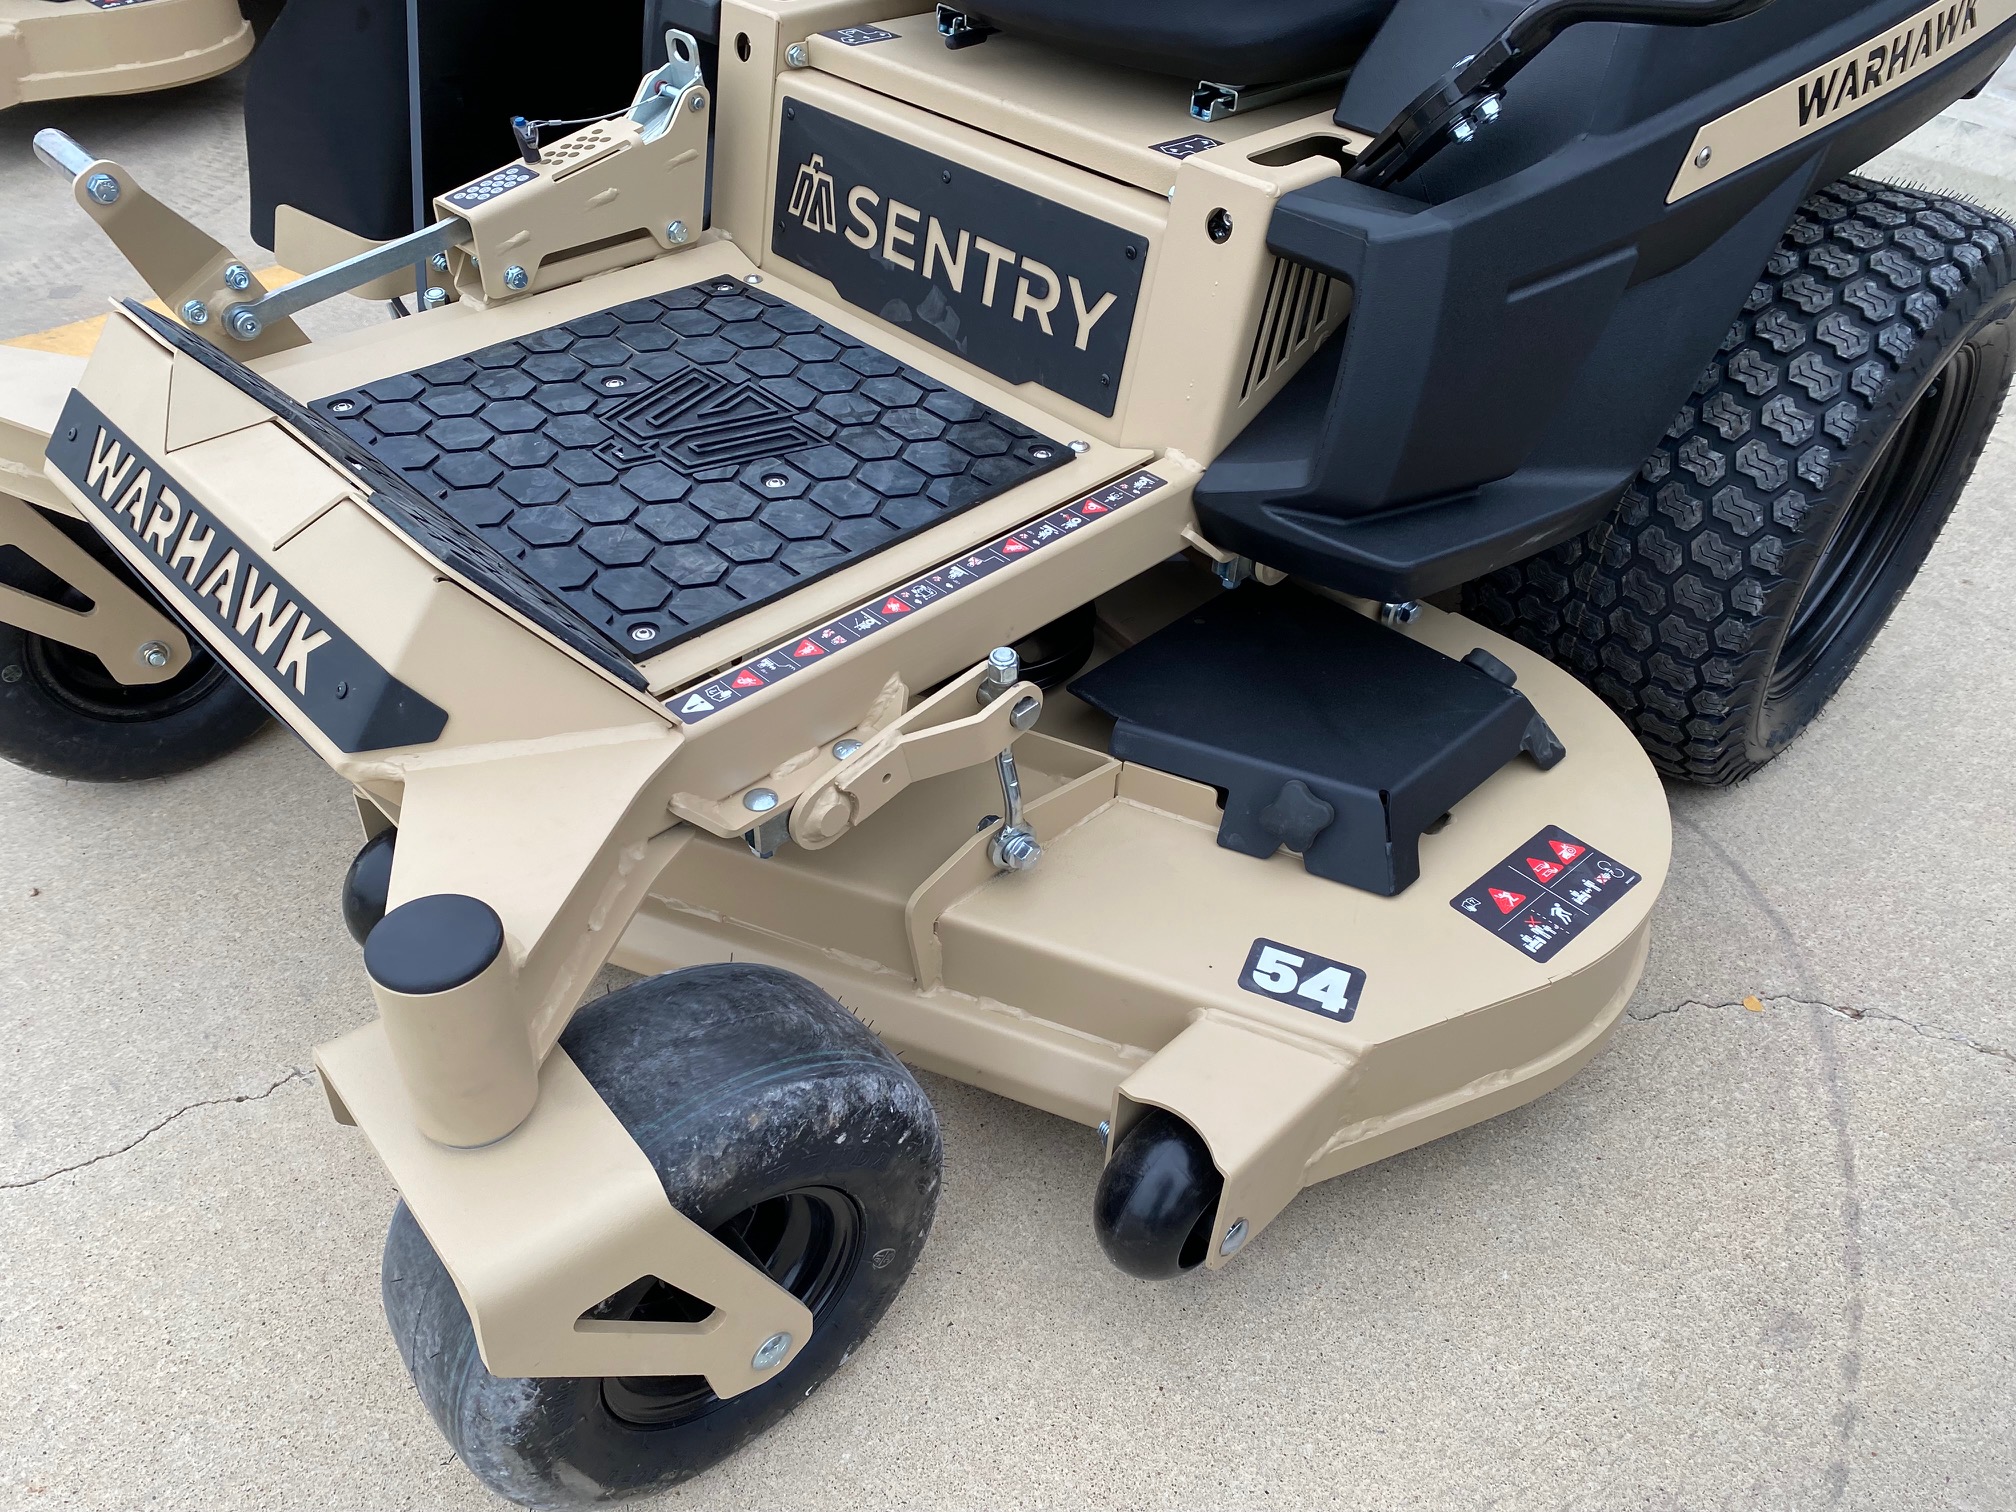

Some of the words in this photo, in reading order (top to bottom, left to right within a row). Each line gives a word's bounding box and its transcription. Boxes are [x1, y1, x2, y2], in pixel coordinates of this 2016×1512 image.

[1798, 0, 1978, 127] WARHAWK
[842, 183, 1119, 352] SENTRY
[84, 424, 332, 696] WARHAWK
[1252, 945, 1348, 1014] 54
